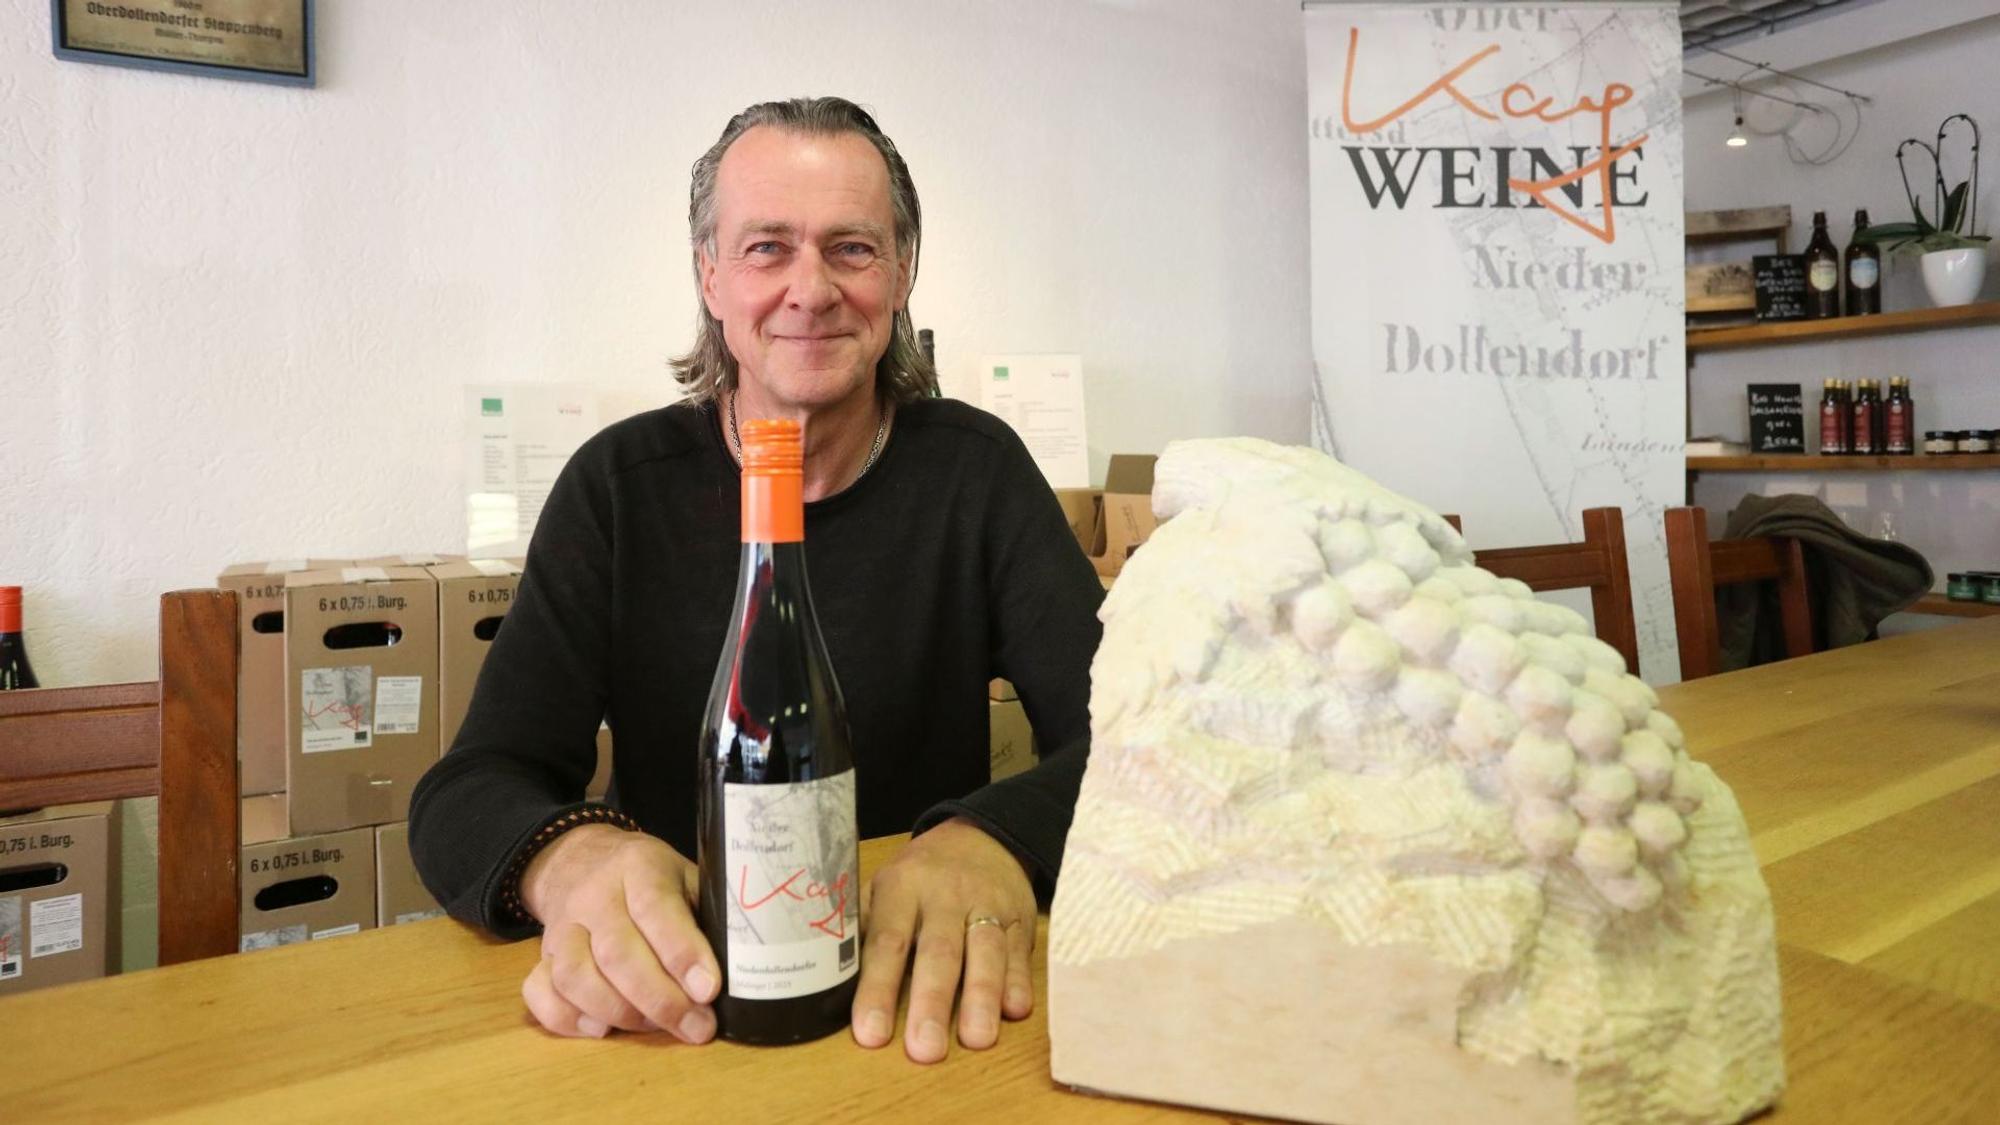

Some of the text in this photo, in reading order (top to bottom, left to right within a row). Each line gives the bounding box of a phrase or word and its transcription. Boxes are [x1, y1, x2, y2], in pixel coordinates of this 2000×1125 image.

[1341, 146, 1649, 210] WEINE
[246, 585, 253, 598] 6
[469, 590, 475, 603] 6
[478, 592, 484, 602] x
[487, 589, 509, 604] 0,75
[319, 598, 326, 611] 6
[330, 601, 337, 610] x
[340, 597, 364, 612] 0,75
[377, 595, 407, 610] Burg.
[41, 835, 74, 848] Burg.
[250, 859, 259, 873] 6
[262, 860, 269, 871] x
[273, 852, 299, 871] 0,75
[312, 848, 344, 863] Burg.
